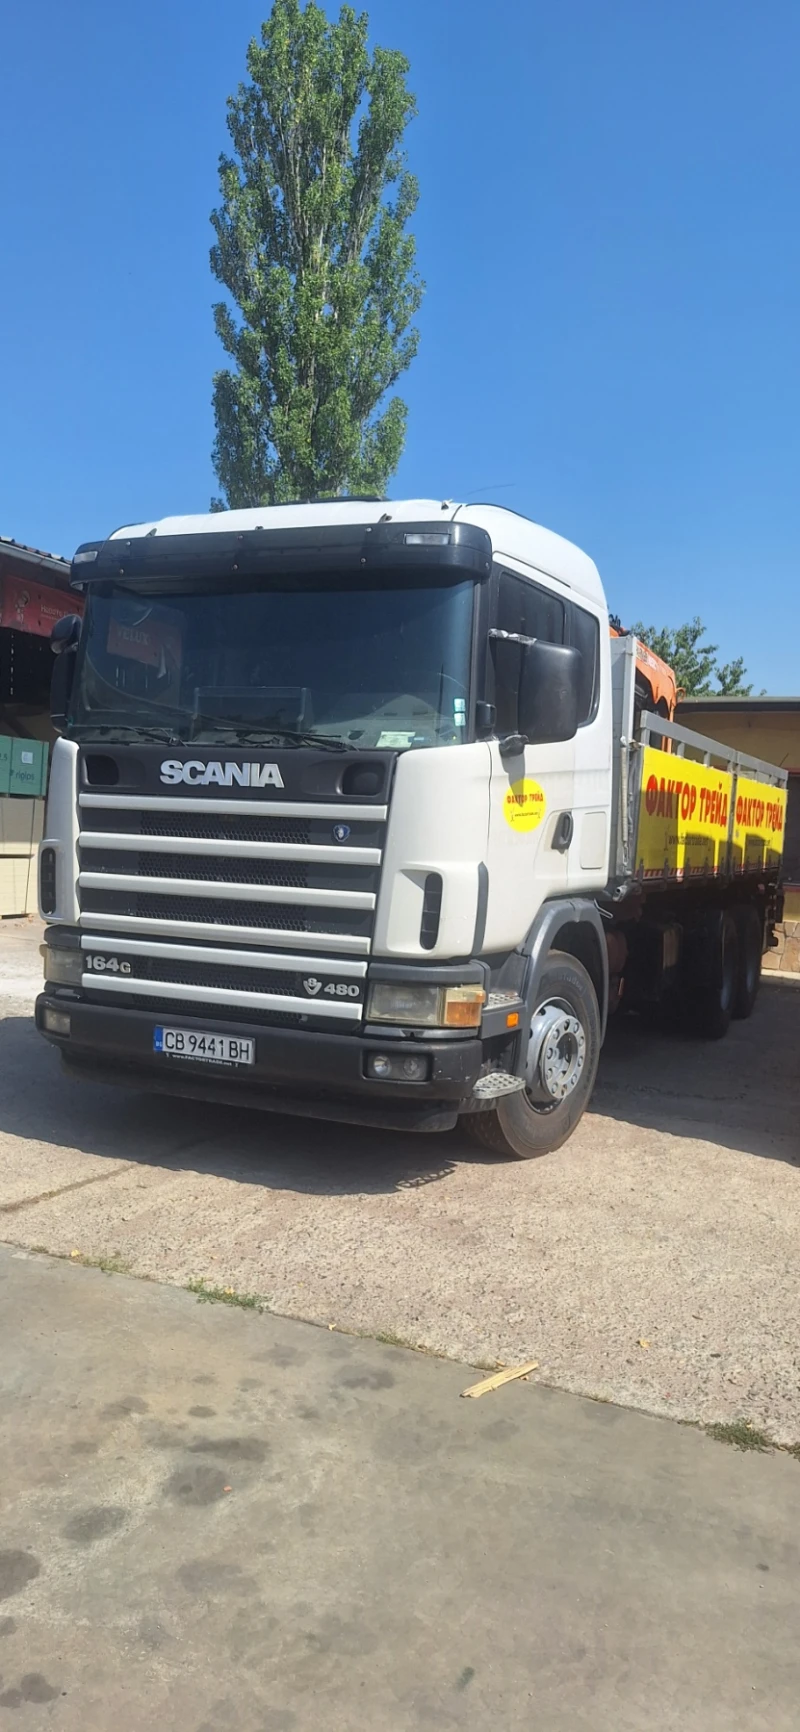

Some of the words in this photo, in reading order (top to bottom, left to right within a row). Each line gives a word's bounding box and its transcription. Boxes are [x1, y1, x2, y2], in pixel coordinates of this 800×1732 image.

[160, 760, 285, 789] SCANIA
[645, 774, 697, 820] ФАКТОР
[699, 781, 728, 828] ТРЕЙД
[736, 796, 765, 829] ФАКТОР
[766, 797, 783, 832] ТРЕЙД
[323, 983, 360, 997] 480
[165, 1032, 184, 1051] CB
[189, 1035, 224, 1056] 9441
[229, 1041, 250, 1060] BH
